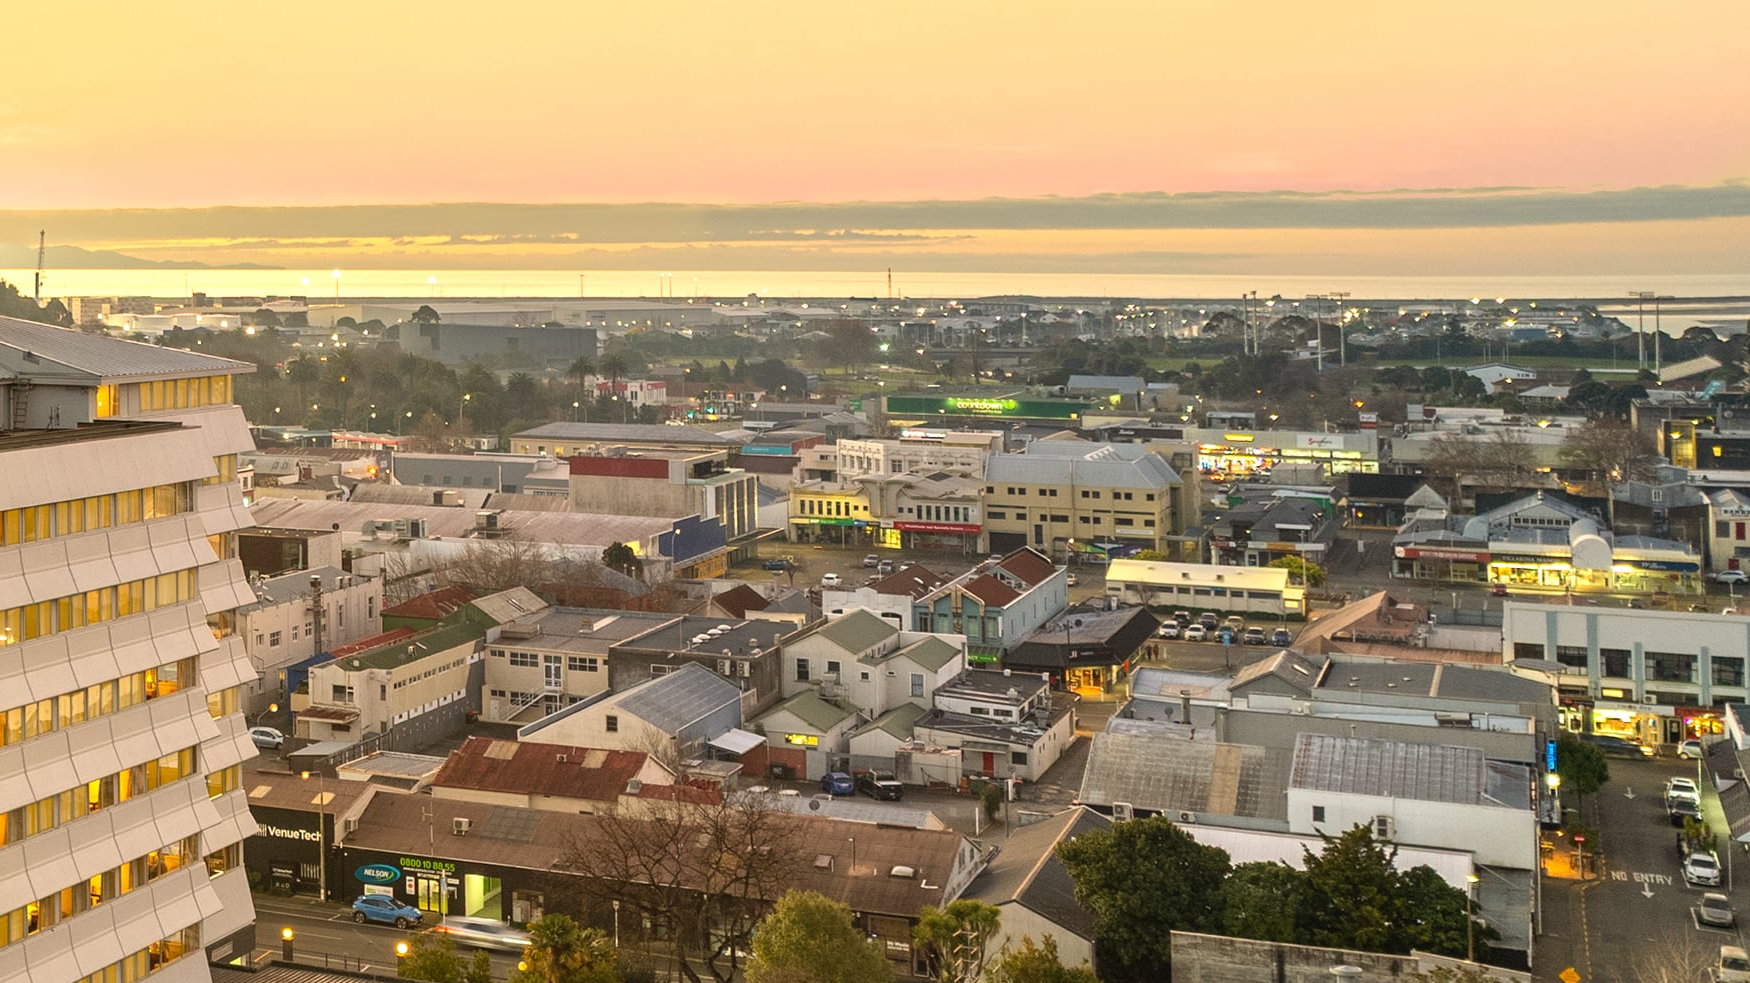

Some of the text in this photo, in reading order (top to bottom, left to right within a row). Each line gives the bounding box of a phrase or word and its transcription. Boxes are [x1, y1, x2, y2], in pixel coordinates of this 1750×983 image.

[957, 400, 1003, 409] countdown
[399, 857, 421, 868] 0800
[422, 860, 432, 869] 10
[432, 861, 444, 870] 88
[444, 862, 455, 872] 55
[363, 868, 389, 878] NELSON
[1610, 871, 1673, 886] NO ENTRY
